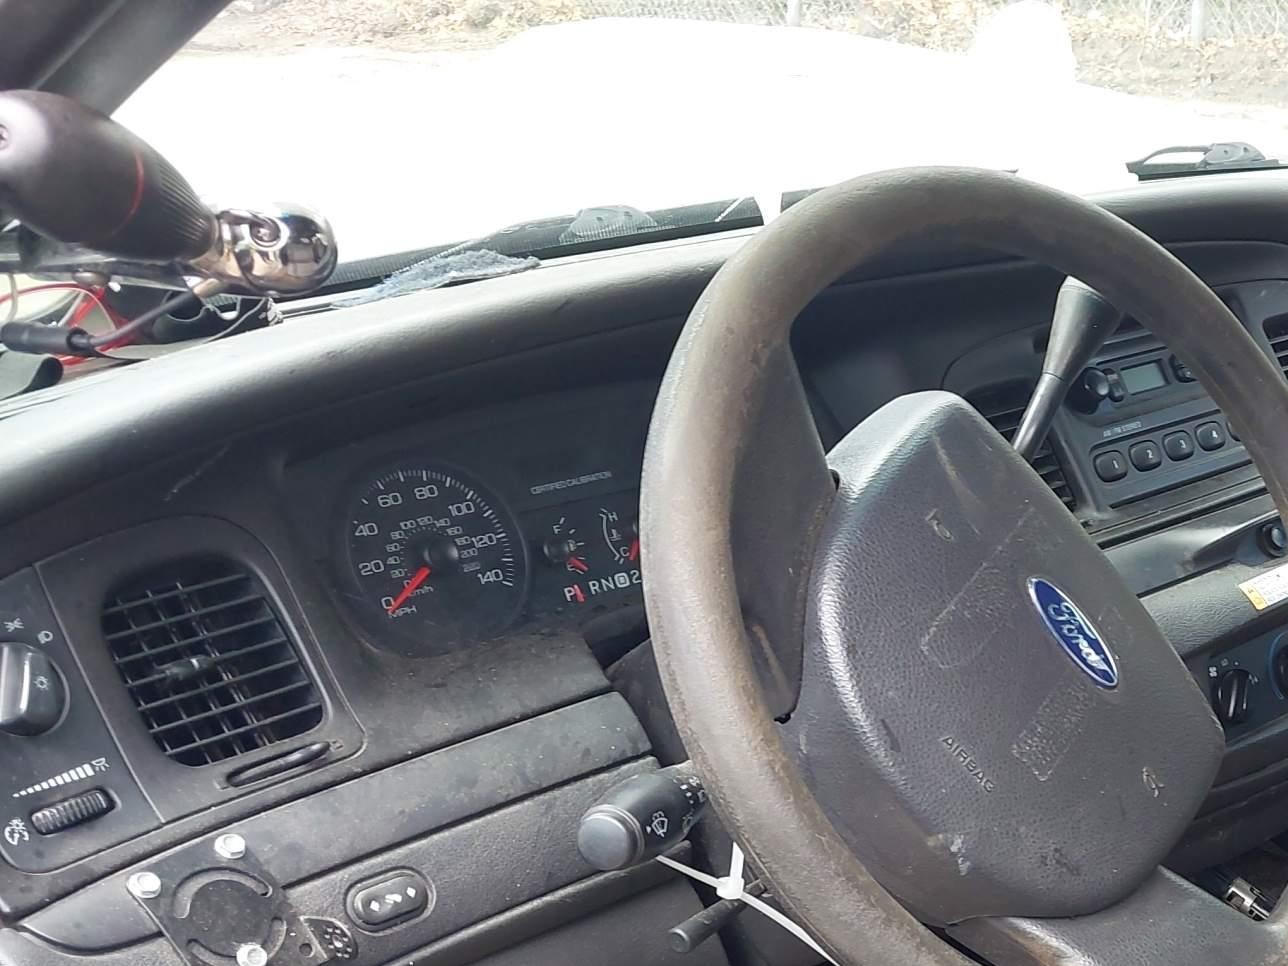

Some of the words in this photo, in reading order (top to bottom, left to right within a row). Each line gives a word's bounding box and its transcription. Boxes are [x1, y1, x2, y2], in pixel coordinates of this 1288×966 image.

[1146, 449, 1153, 459] 2
[1179, 439, 1186, 449] 3
[378, 492, 402, 507] 60
[414, 485, 438, 500] 80
[448, 501, 475, 516] 100
[608, 511, 618, 522] H
[355, 523, 378, 537] 40
[553, 524, 562, 534] F
[471, 533, 497, 548] 120
[620, 547, 630, 557] C
[358, 560, 384, 576] 20
[386, 556, 400, 566] 40
[477, 569, 503, 585] 140
[563, 586, 576, 602] P
[588, 580, 601, 594] R
[600, 576, 615, 591] N
[630, 570, 641, 583] 2
[381, 597, 394, 609] 0
[1047, 602, 1117, 678] Ford
[941, 735, 995, 793] AIRBAG
